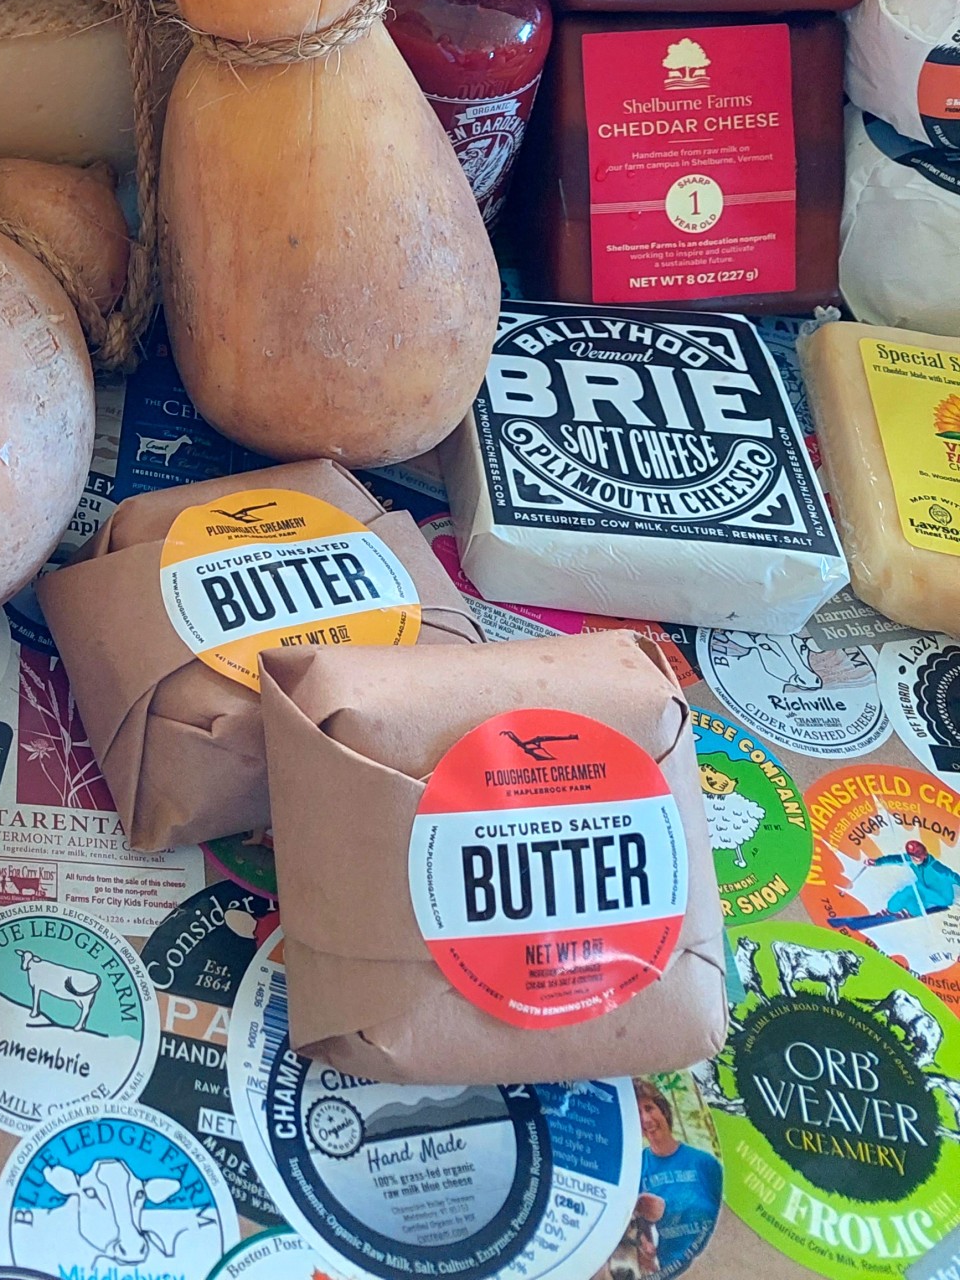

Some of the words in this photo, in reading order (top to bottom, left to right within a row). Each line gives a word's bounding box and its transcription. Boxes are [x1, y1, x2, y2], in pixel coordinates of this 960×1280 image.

[472, 102, 511, 115] ORGANIC
[623, 98, 702, 115] Shelburne
[708, 95, 752, 109] Farms
[598, 118, 698, 138] CHEDDAR
[704, 113, 779, 131] CHEESE
[677, 177, 711, 189] SHARP
[688, 191, 701, 216] 1
[674, 216, 697, 231] YEAR
[700, 213, 717, 229] OLD
[512, 320, 710, 368] BALLYHOO
[569, 342, 654, 362] Vermont
[876, 342, 945, 370] Special
[485, 352, 773, 438] BRIE
[560, 424, 632, 474] SOFT
[629, 429, 719, 480] CHEESE
[526, 437, 678, 516] PLYMOUTH
[678, 457, 765, 513] CHEESE
[514, 512, 596, 526] PASTEURIZED
[601, 519, 630, 529] COW
[783, 535, 813, 546] SALT
[196, 551, 273, 575] CULTURED
[277, 541, 350, 557] UNSALTED
[201, 552, 381, 633] BUTTER
[769, 695, 847, 712] Richville
[745, 702, 786, 731] CIDER
[788, 728, 846, 742] WASHED
[845, 702, 878, 737] CHEESE
[485, 767, 548, 787] PLOUGHGATE
[551, 763, 607, 780] CREAMERY
[737, 739, 806, 830] COMPANY
[811, 774, 911, 838] MANSFIELD
[67, 835, 119, 850] ALPINE
[474, 821, 562, 838] CULTURED
[570, 815, 632, 832] SALTED
[848, 812, 887, 846] SUGAR
[895, 812, 956, 843] SLALOM
[461, 832, 651, 923] BUTTER
[736, 874, 791, 914] SNOW
[145, 895, 254, 991] Consider
[194, 974, 230, 992] 1864
[203, 960, 231, 977] Est.
[784, 1042, 879, 1092] ORB
[752, 1074, 928, 1146] WEAVER
[367, 1147, 414, 1173] Hand
[419, 1137, 467, 1162] Made
[786, 1128, 907, 1177] CREAMERY
[14, 1150, 61, 1228] BLUE
[61, 1122, 154, 1156] LEDGE
[159, 1147, 218, 1229] FARM
[782, 1185, 935, 1259] FROLIC
